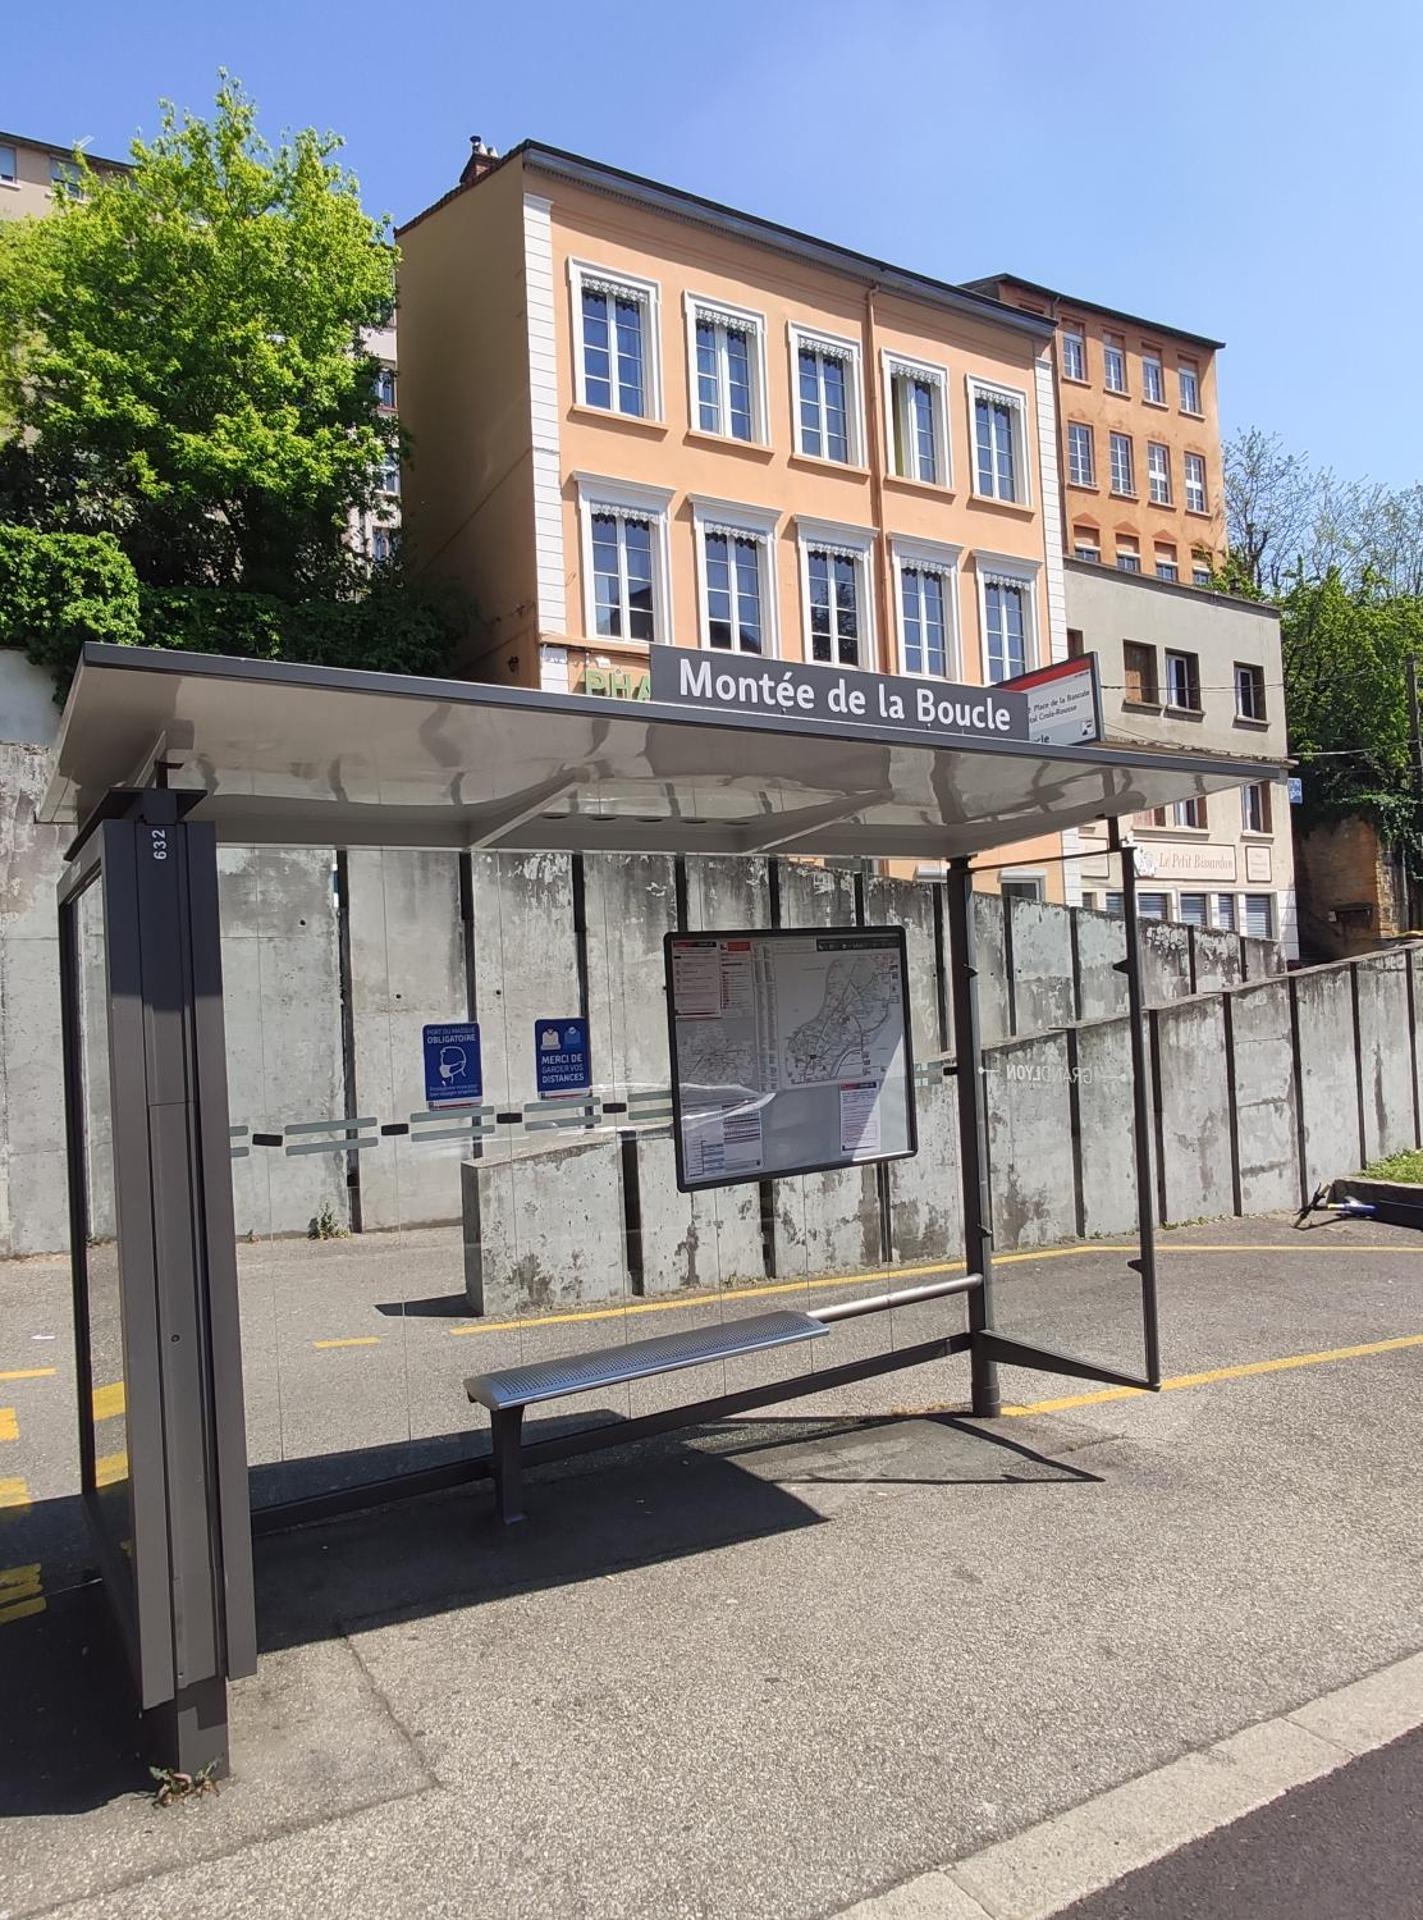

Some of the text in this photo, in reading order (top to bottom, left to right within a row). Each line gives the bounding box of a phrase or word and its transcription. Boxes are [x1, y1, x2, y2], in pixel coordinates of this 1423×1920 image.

[679, 657, 1011, 731] Montée de la Boucle
[1033, 702, 1049, 712] Place
[151, 829, 167, 860] 632
[1158, 853, 1168, 867] Le
[1172, 853, 1192, 868] Petit
[427, 1033, 476, 1044] OBLIGATOIRE
[541, 1053, 583, 1065] MERCI DE
[542, 1073, 585, 1084] DISTANCES
